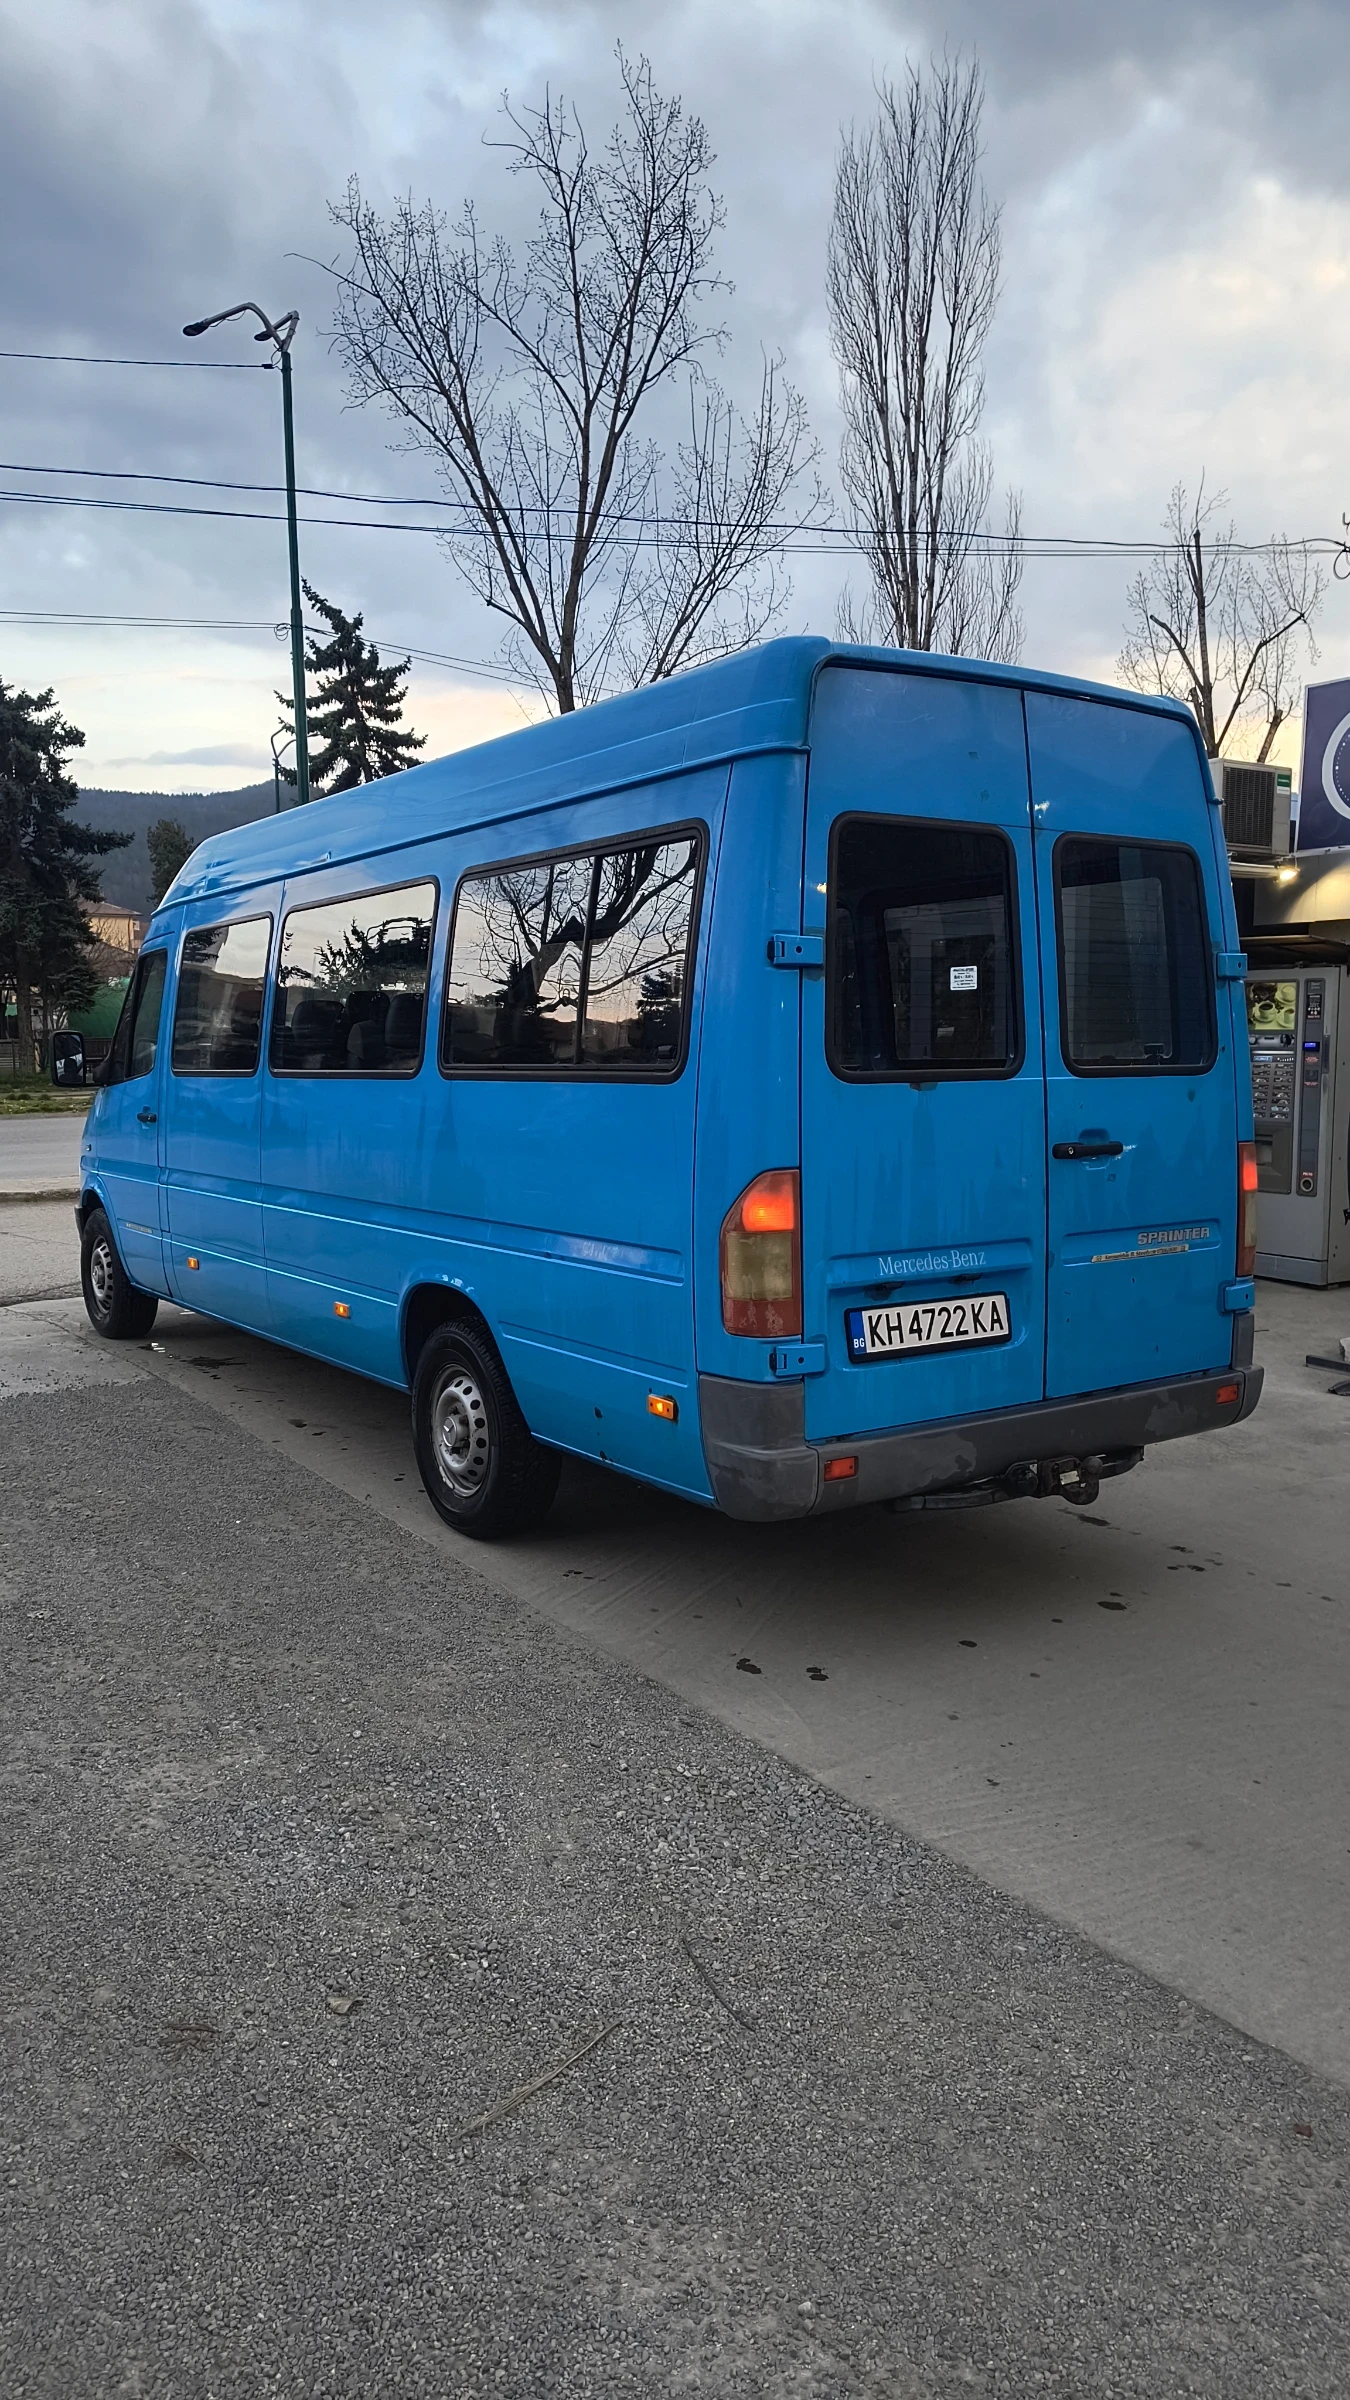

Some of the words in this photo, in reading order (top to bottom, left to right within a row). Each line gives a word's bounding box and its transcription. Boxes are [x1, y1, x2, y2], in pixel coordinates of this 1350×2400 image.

[1137, 1227, 1210, 1245] SPRINTER
[878, 1249, 987, 1276] Mercedes-Benz
[908, 1305, 969, 1342] 4722
[853, 1337, 865, 1349] BG
